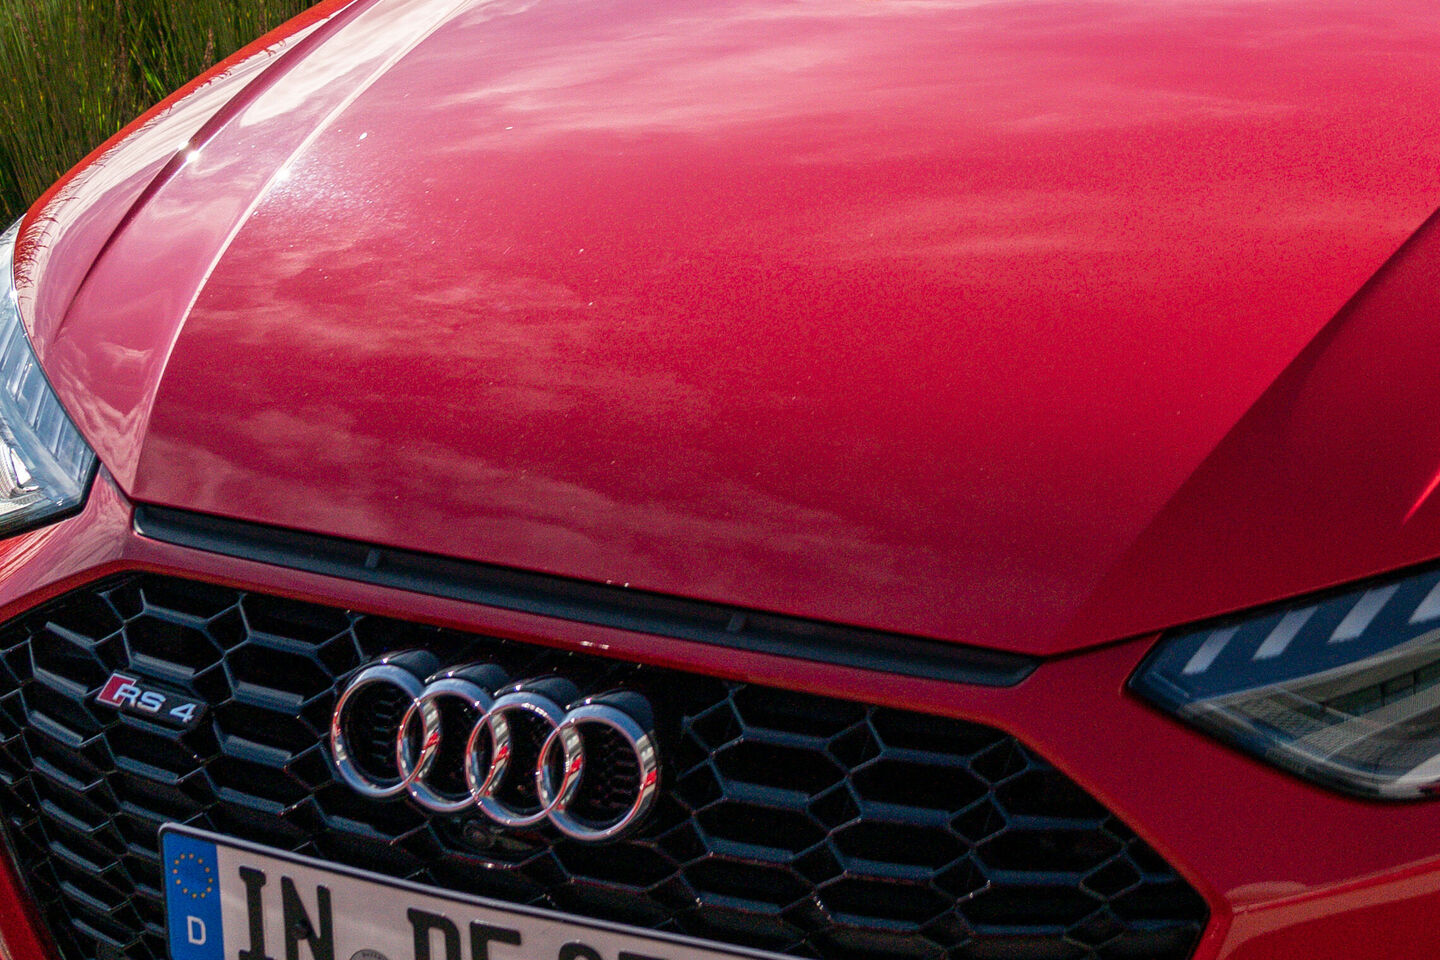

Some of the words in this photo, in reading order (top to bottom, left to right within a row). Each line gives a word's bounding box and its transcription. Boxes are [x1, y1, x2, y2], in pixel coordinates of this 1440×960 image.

[112, 683, 167, 713] RS
[168, 702, 197, 723] 4
[186, 915, 207, 946] D
[238, 865, 336, 960] IN
